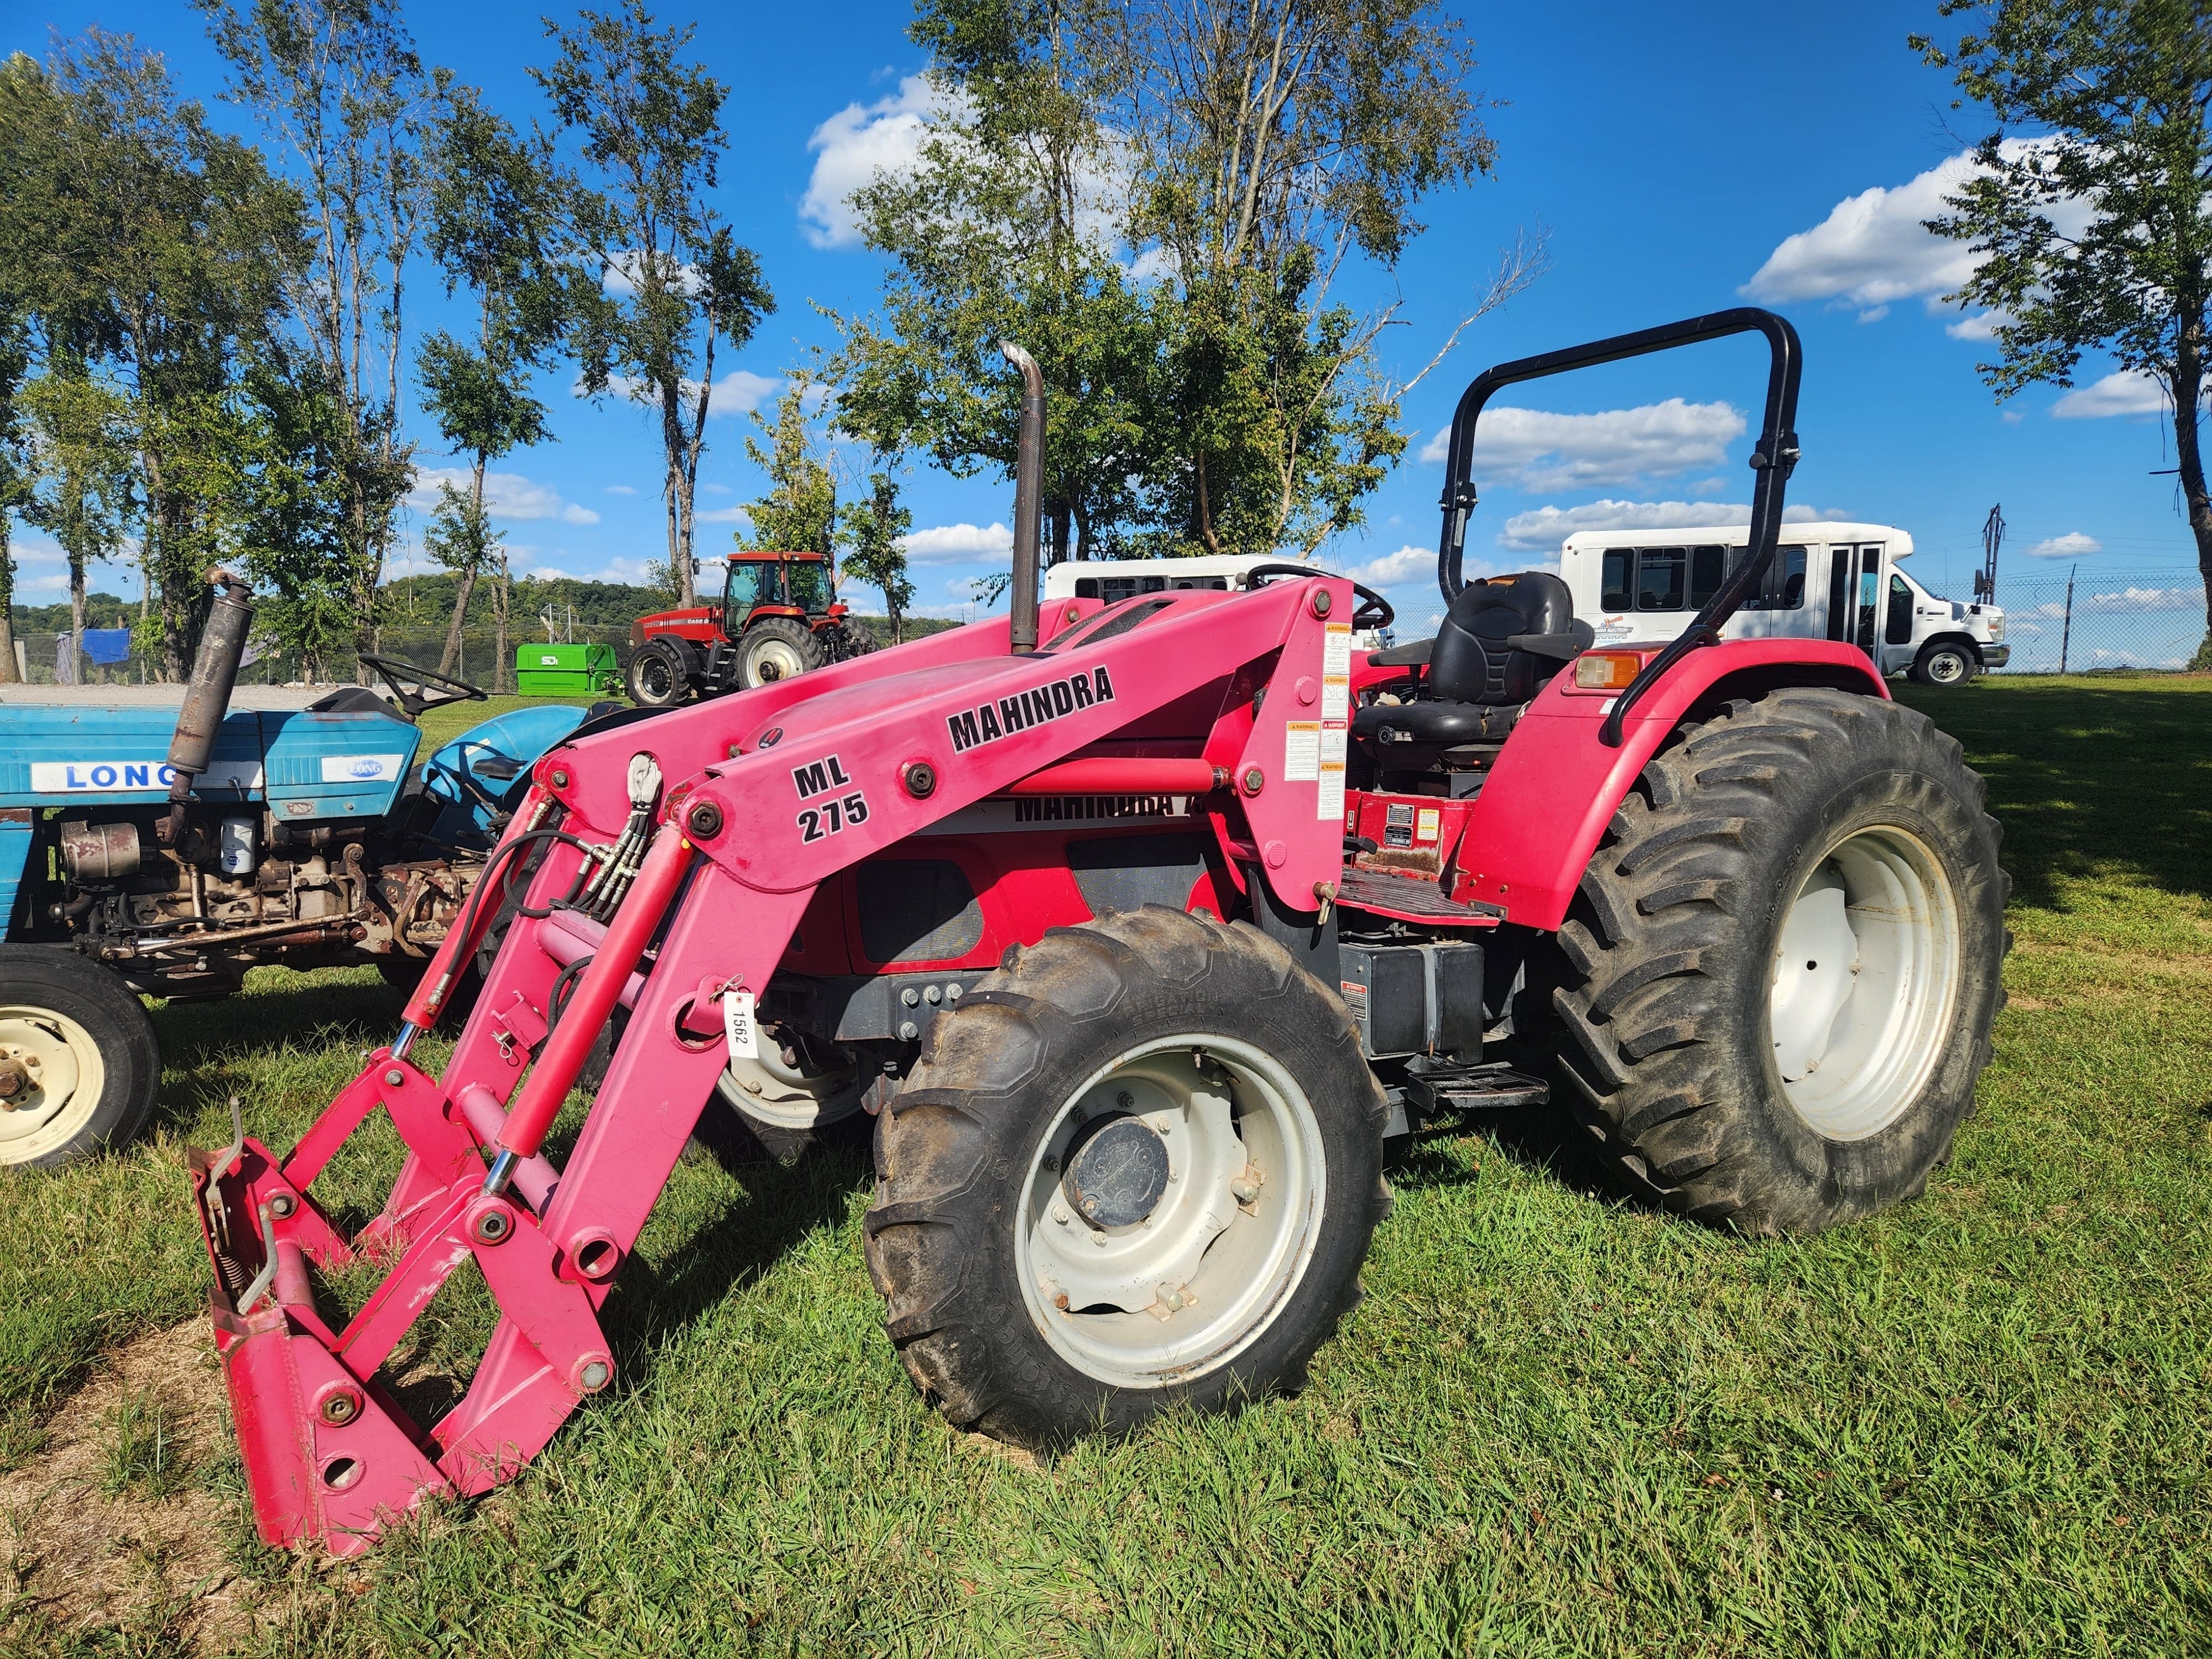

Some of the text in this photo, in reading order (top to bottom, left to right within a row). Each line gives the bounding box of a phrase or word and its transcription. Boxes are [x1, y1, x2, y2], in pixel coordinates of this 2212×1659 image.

[947, 665, 1115, 753] MAHINDRA
[66, 765, 176, 788] LONG
[792, 755, 850, 799] ML
[797, 791, 869, 843] 275
[1014, 796, 1173, 822] MAHINDRA
[733, 1011, 748, 1044] 1562
[1133, 1004, 1204, 1027] SPECIAL
